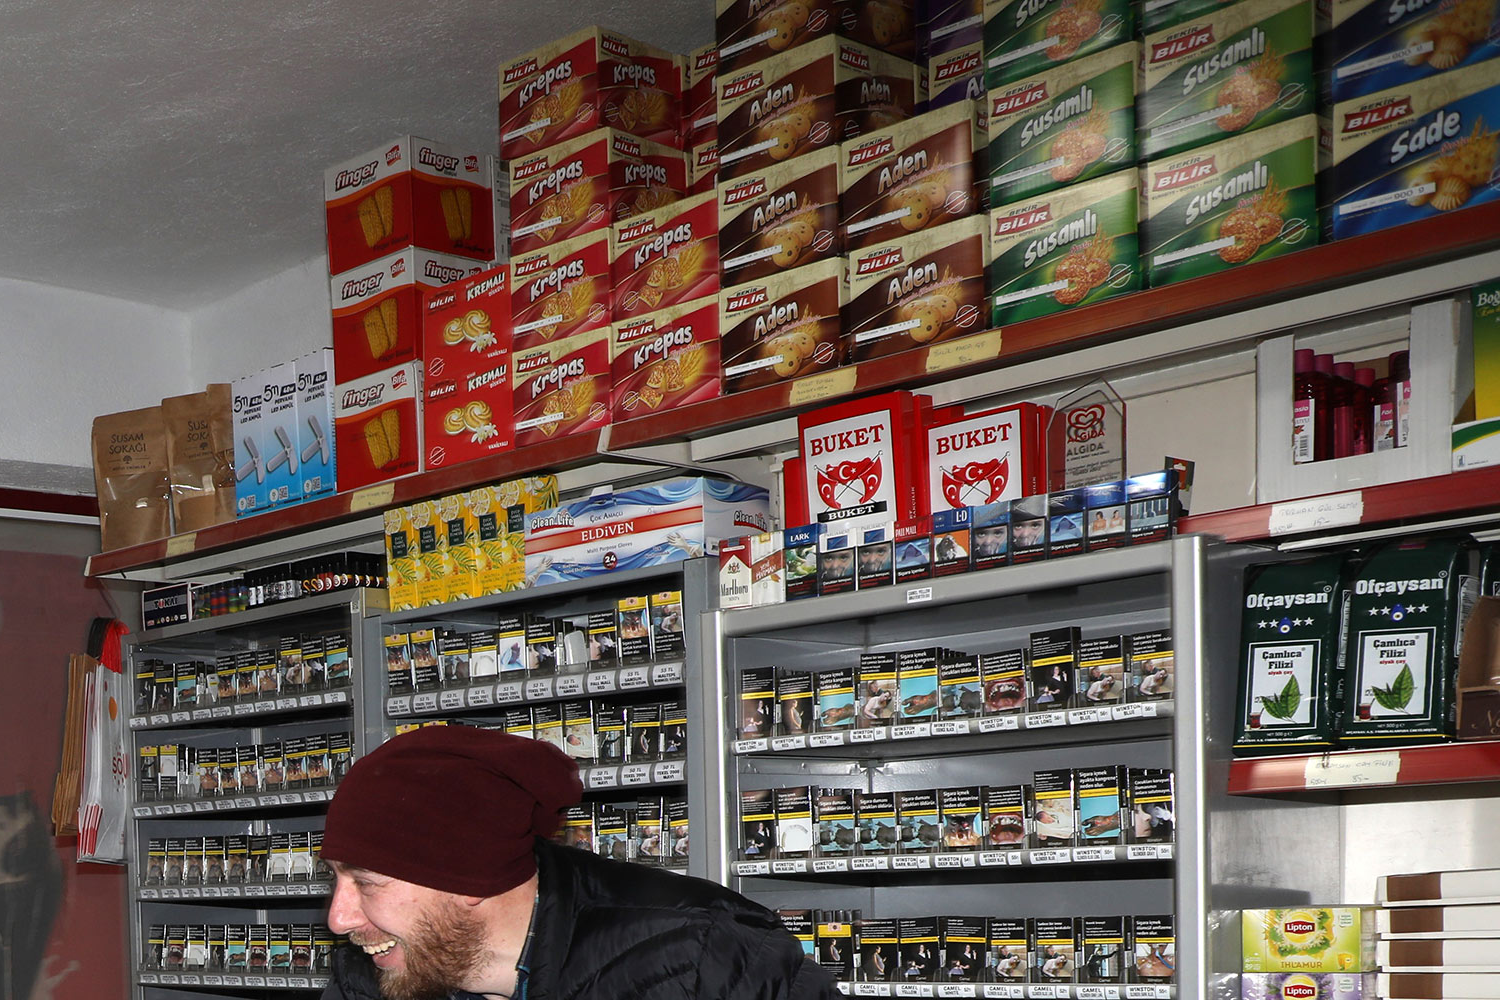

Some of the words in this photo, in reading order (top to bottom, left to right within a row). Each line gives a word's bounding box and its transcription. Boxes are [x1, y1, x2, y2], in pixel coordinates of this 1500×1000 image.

[613, 64, 656, 85] Krepas
[748, 81, 793, 125] Aden
[1390, 110, 1461, 163] Sade
[419, 147, 458, 170] finger
[529, 159, 583, 204] Krepas
[887, 260, 938, 303] Aden
[754, 300, 797, 341] Aden
[633, 325, 692, 370] Krepas
[468, 364, 508, 392] KREMALI
[532, 355, 584, 398] Krepas
[342, 382, 383, 409] finger
[111, 433, 144, 444] SUSAM
[810, 424, 884, 456] BUKET
[936, 424, 1012, 455] BUKET
[828, 505, 874, 520] BUKET
[790, 533, 809, 542] LARK
[604, 555, 616, 563] 24
[721, 579, 748, 596] Marlboro
[1356, 577, 1444, 597] Ofçaysan
[1247, 592, 1328, 610] Ofçaysan
[1373, 639, 1416, 648] Çamlıca
[1380, 649, 1407, 658] Filizi
[1262, 650, 1302, 660] Çamlıca
[1268, 661, 1293, 669] Filizi
[1287, 924, 1312, 932] Lipton
[1287, 987, 1312, 995] Lipton
